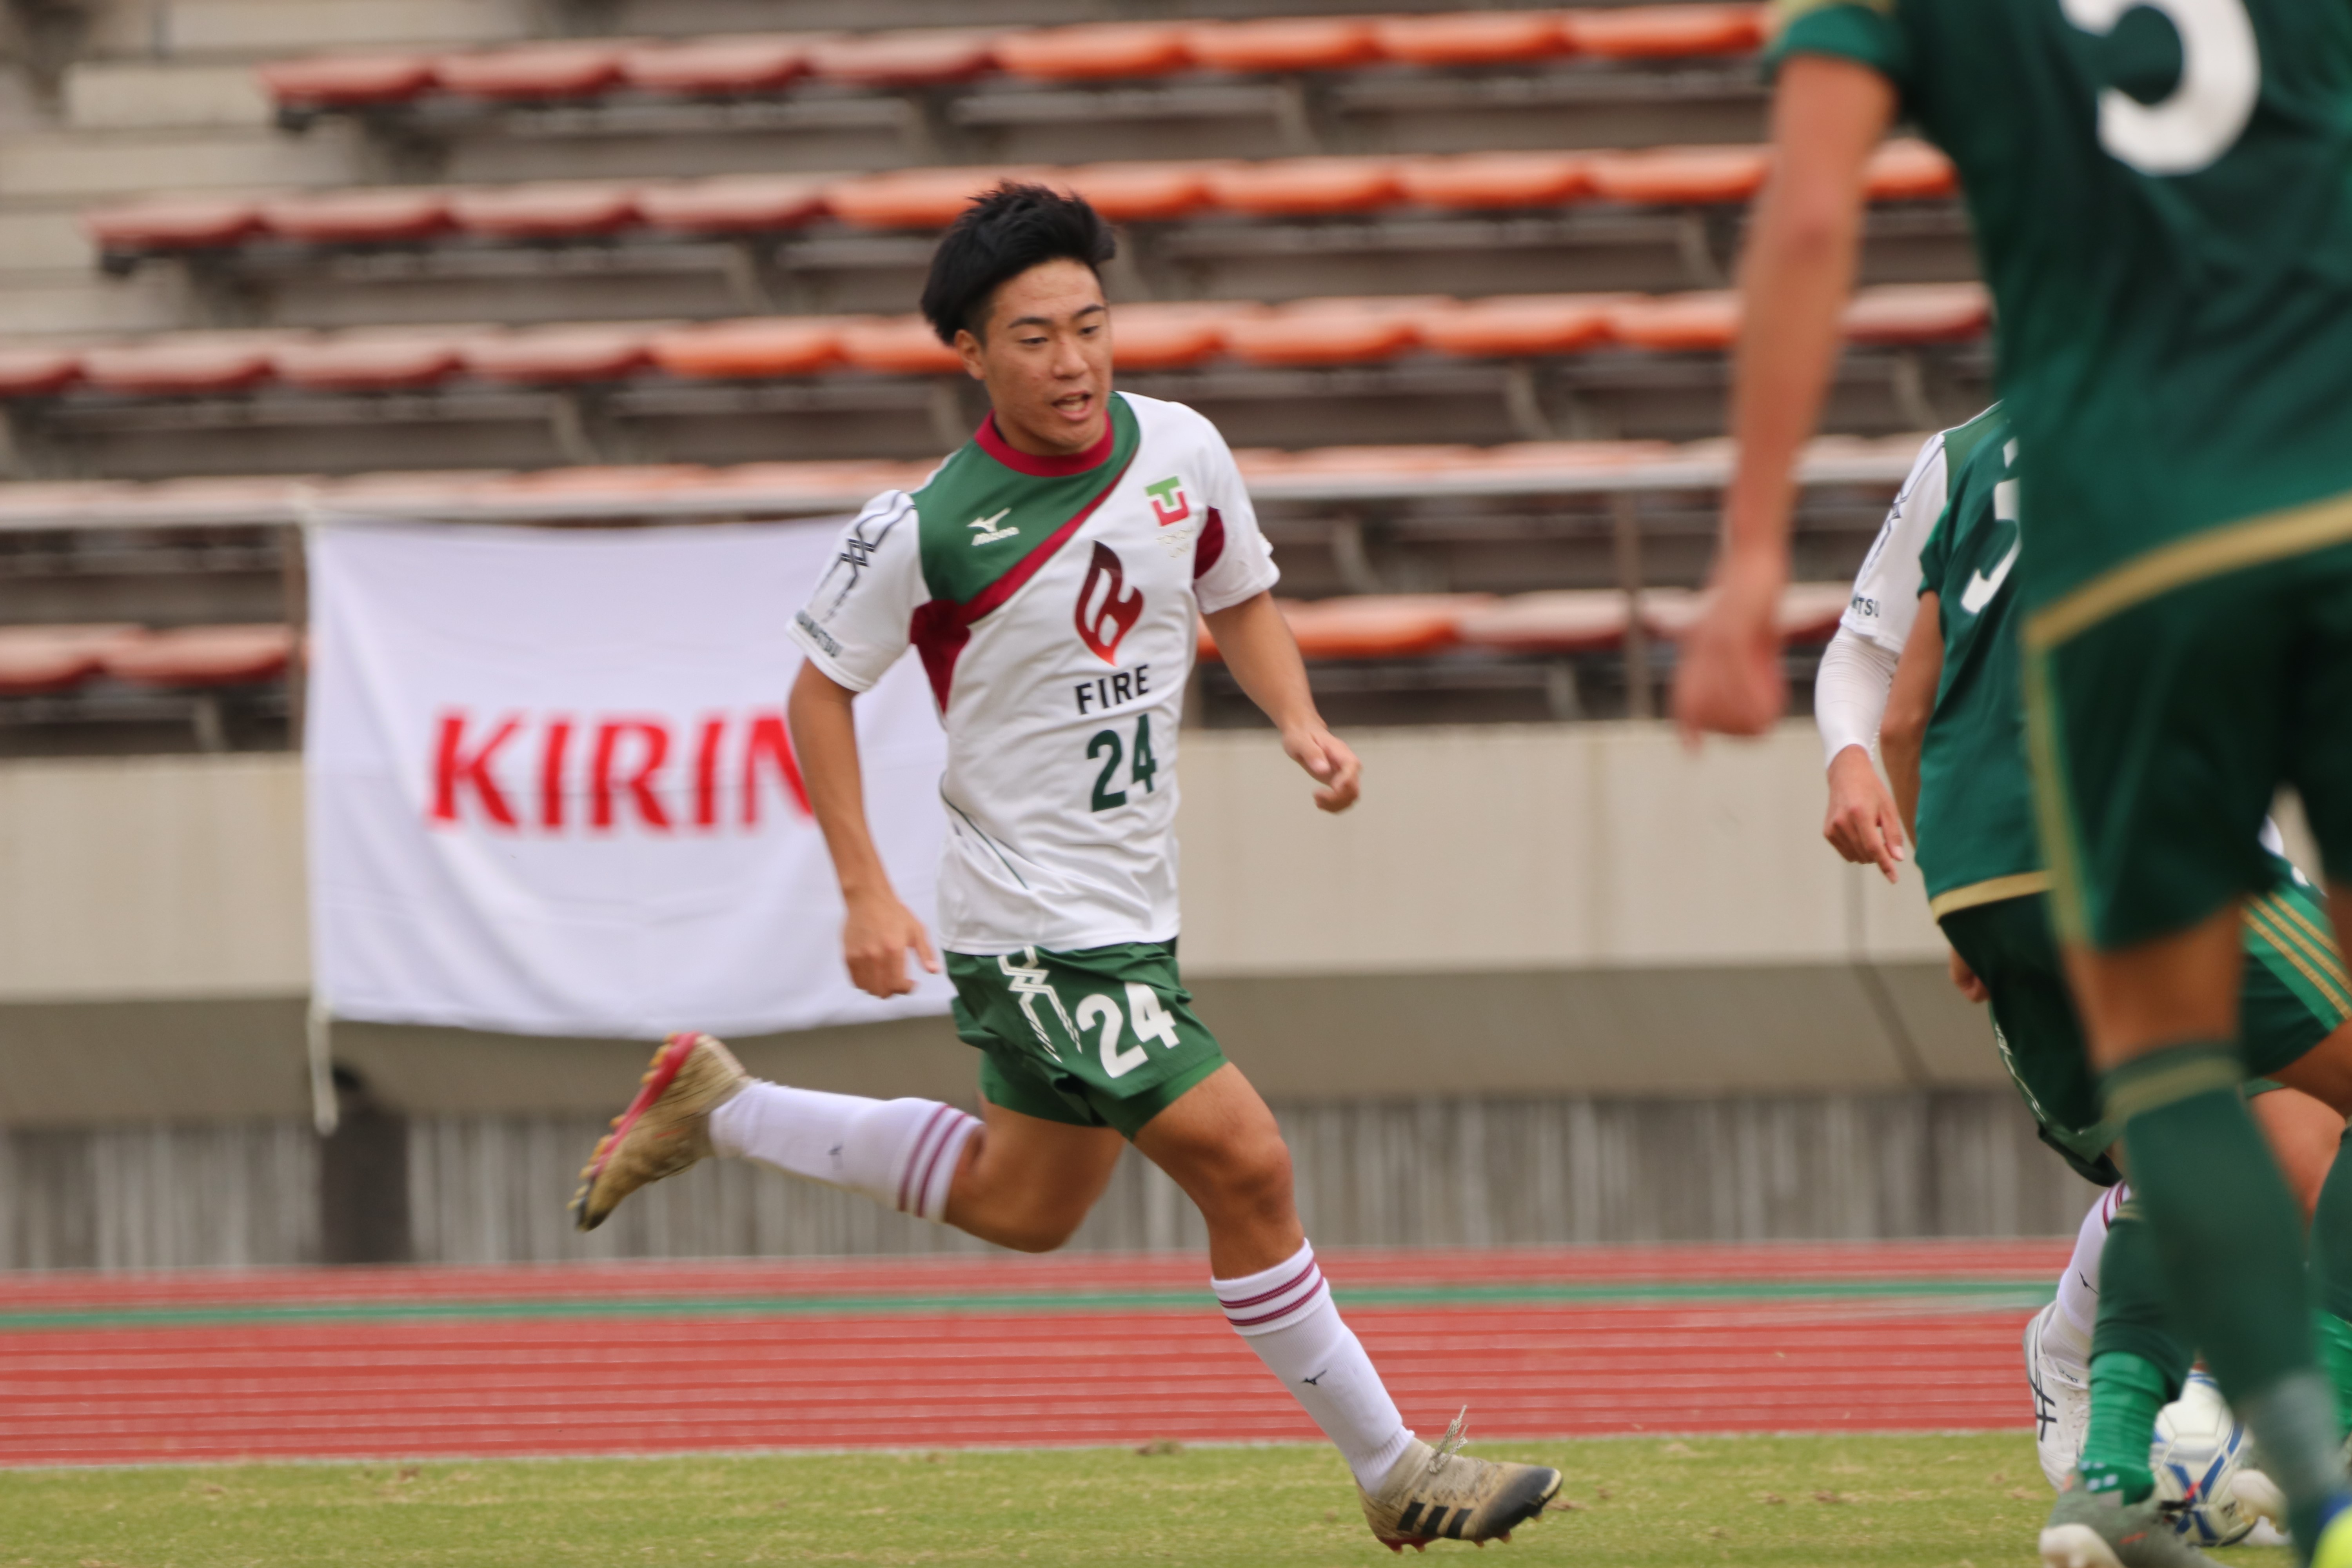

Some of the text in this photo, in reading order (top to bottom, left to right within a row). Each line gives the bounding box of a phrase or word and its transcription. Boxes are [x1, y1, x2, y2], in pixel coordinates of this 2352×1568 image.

[1075, 664, 1150, 715] FIRE
[429, 714, 817, 831] KIRIN
[1087, 713, 1157, 812] 24
[1076, 982, 1181, 1079] 24
